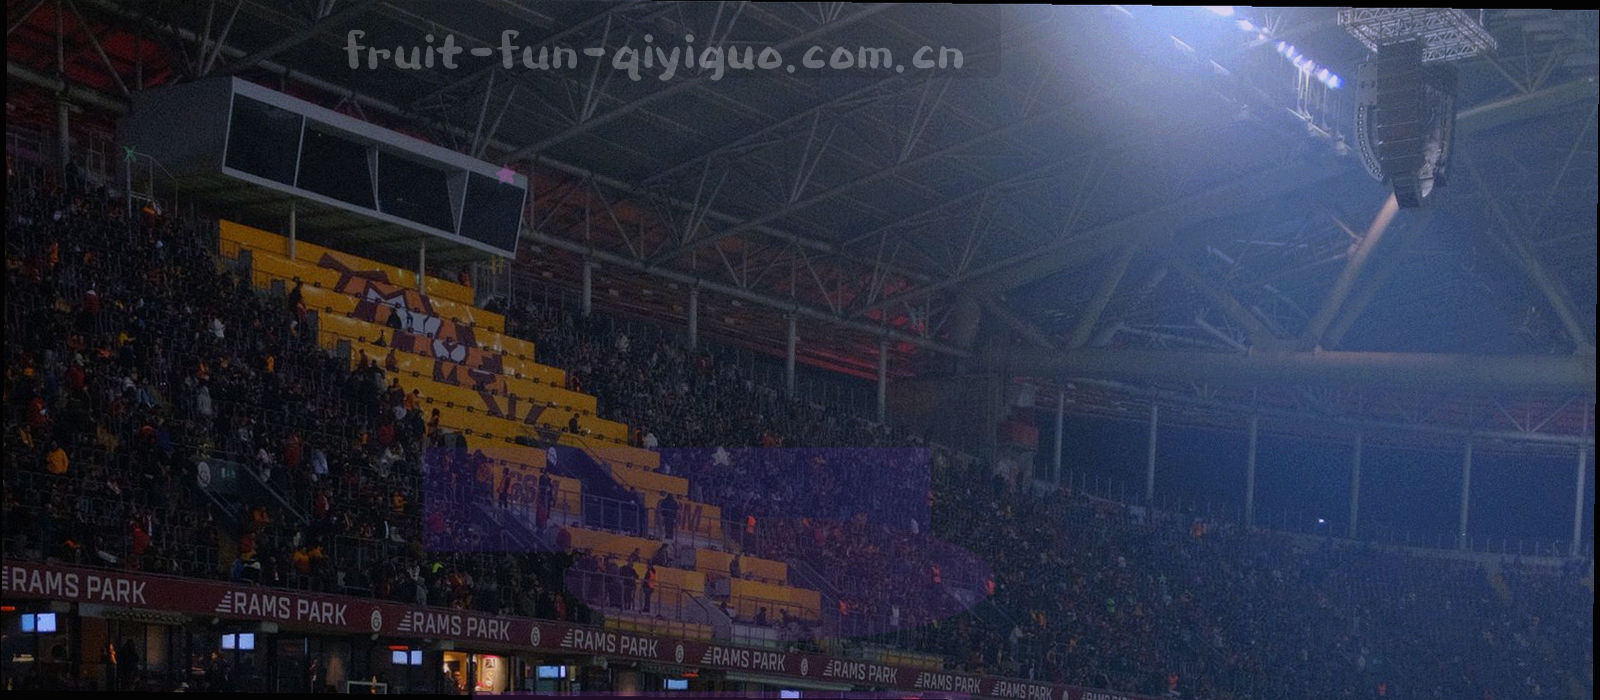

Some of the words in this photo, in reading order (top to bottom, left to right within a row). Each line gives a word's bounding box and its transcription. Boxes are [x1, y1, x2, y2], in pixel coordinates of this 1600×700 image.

[12, 567, 79, 599] RAMS
[86, 576, 147, 605] PARK
[233, 591, 291, 620] RAMS
[297, 598, 348, 626] PARK
[412, 609, 461, 635] RAMS
[466, 616, 511, 642] PARK
[573, 628, 616, 651] RAMS
[620, 634, 659, 659] PARK
[712, 645, 749, 667] RAMS
[752, 651, 787, 672] PARK
[833, 660, 866, 680] RAMS
[868, 664, 898, 685] PARK
[922, 672, 953, 691] RAMS
[955, 676, 981, 695] PARK
[1000, 681, 1025, 699] RAMS
[1028, 685, 1052, 700] PARK
